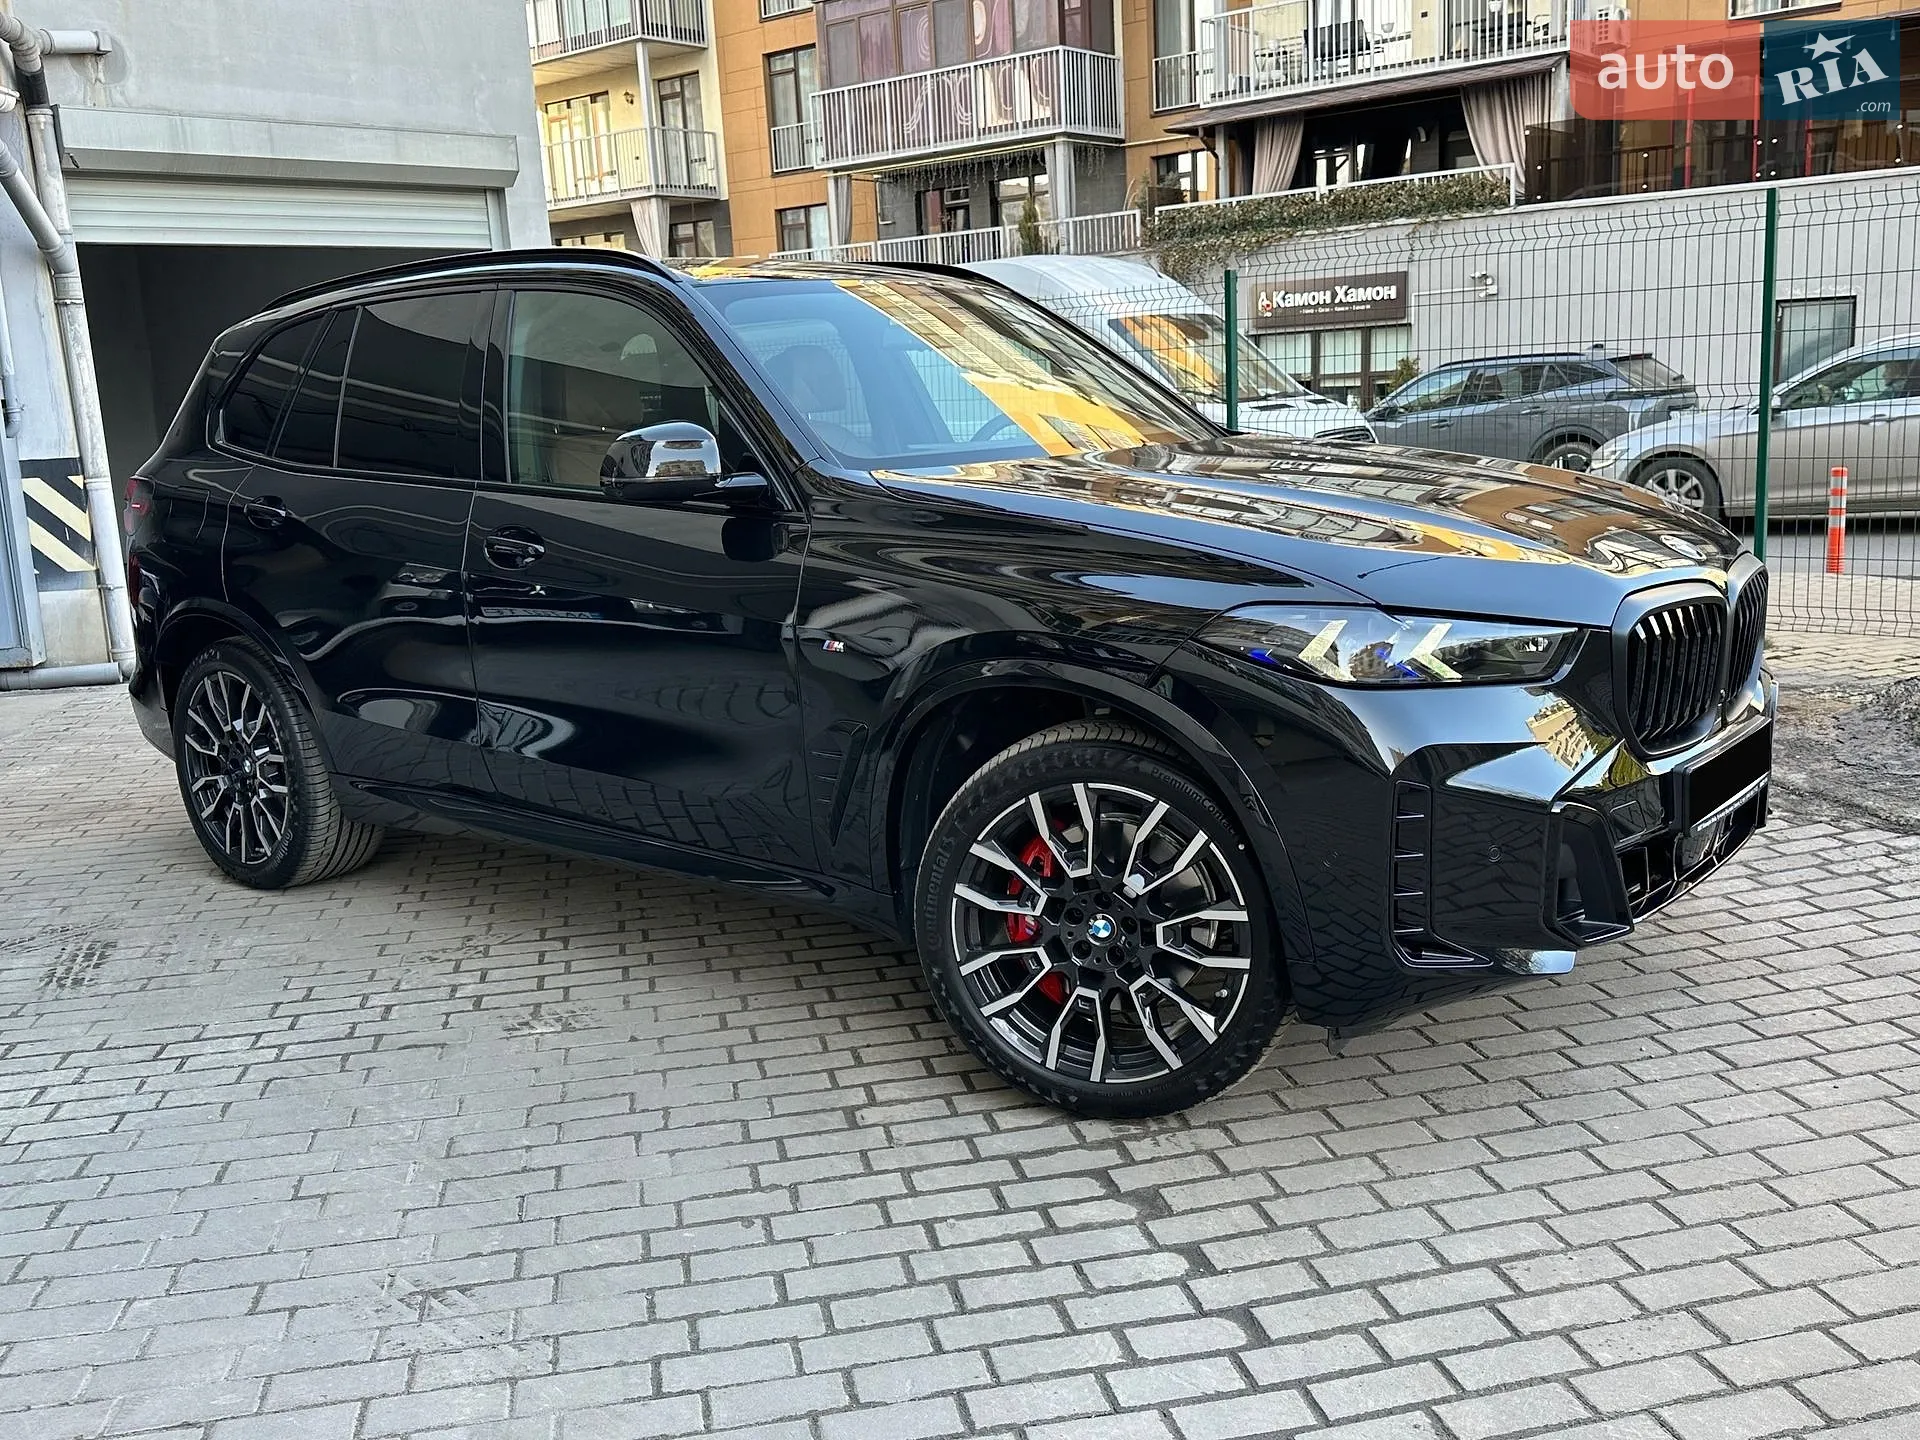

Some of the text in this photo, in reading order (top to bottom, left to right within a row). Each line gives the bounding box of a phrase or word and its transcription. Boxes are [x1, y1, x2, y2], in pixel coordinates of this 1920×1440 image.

[1272, 285, 1397, 308] Камон Хамон
[1151, 766, 1237, 838] PremiumContac
